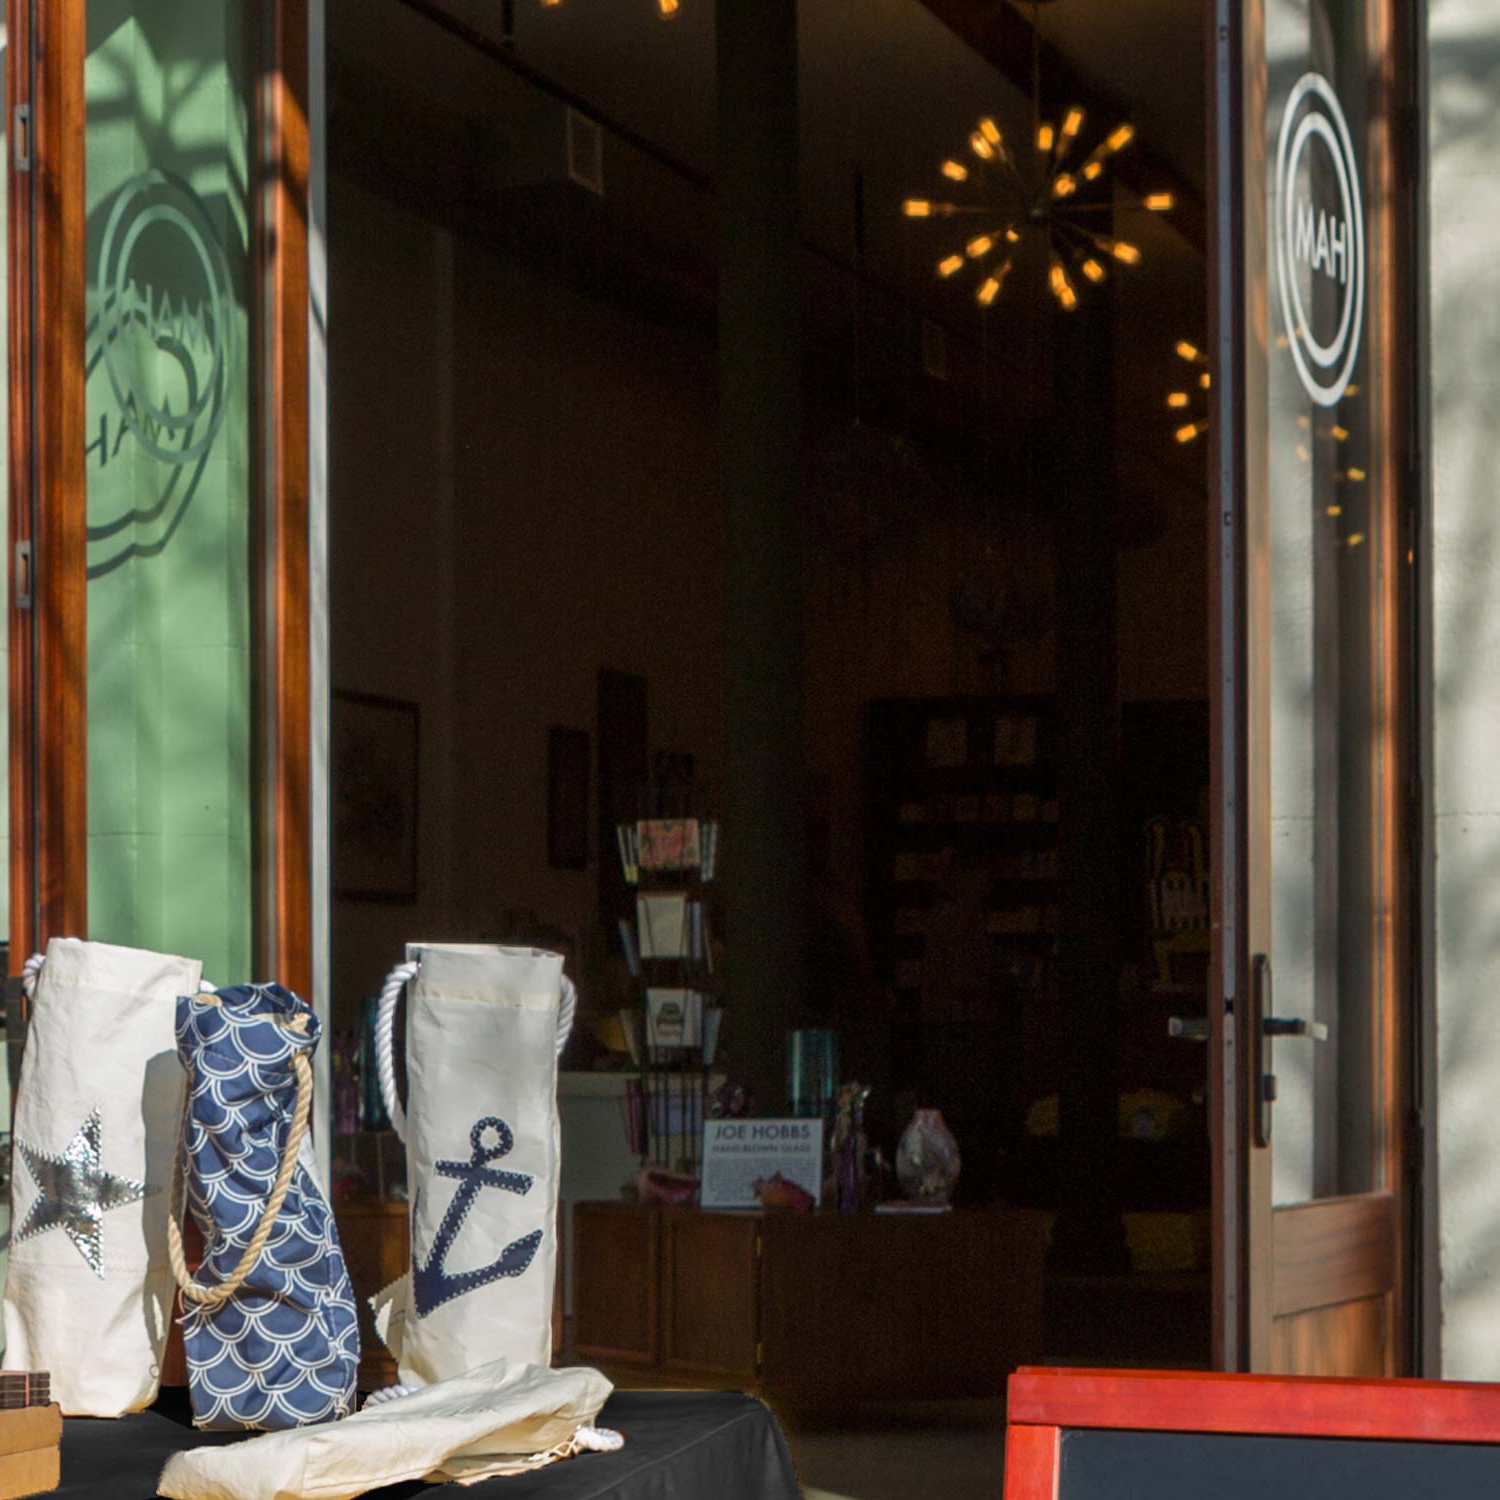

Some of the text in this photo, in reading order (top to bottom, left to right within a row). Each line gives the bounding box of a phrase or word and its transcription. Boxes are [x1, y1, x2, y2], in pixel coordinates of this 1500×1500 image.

[1297, 197, 1346, 284] MAH
[715, 1124, 810, 1139] JOE HOBBS
